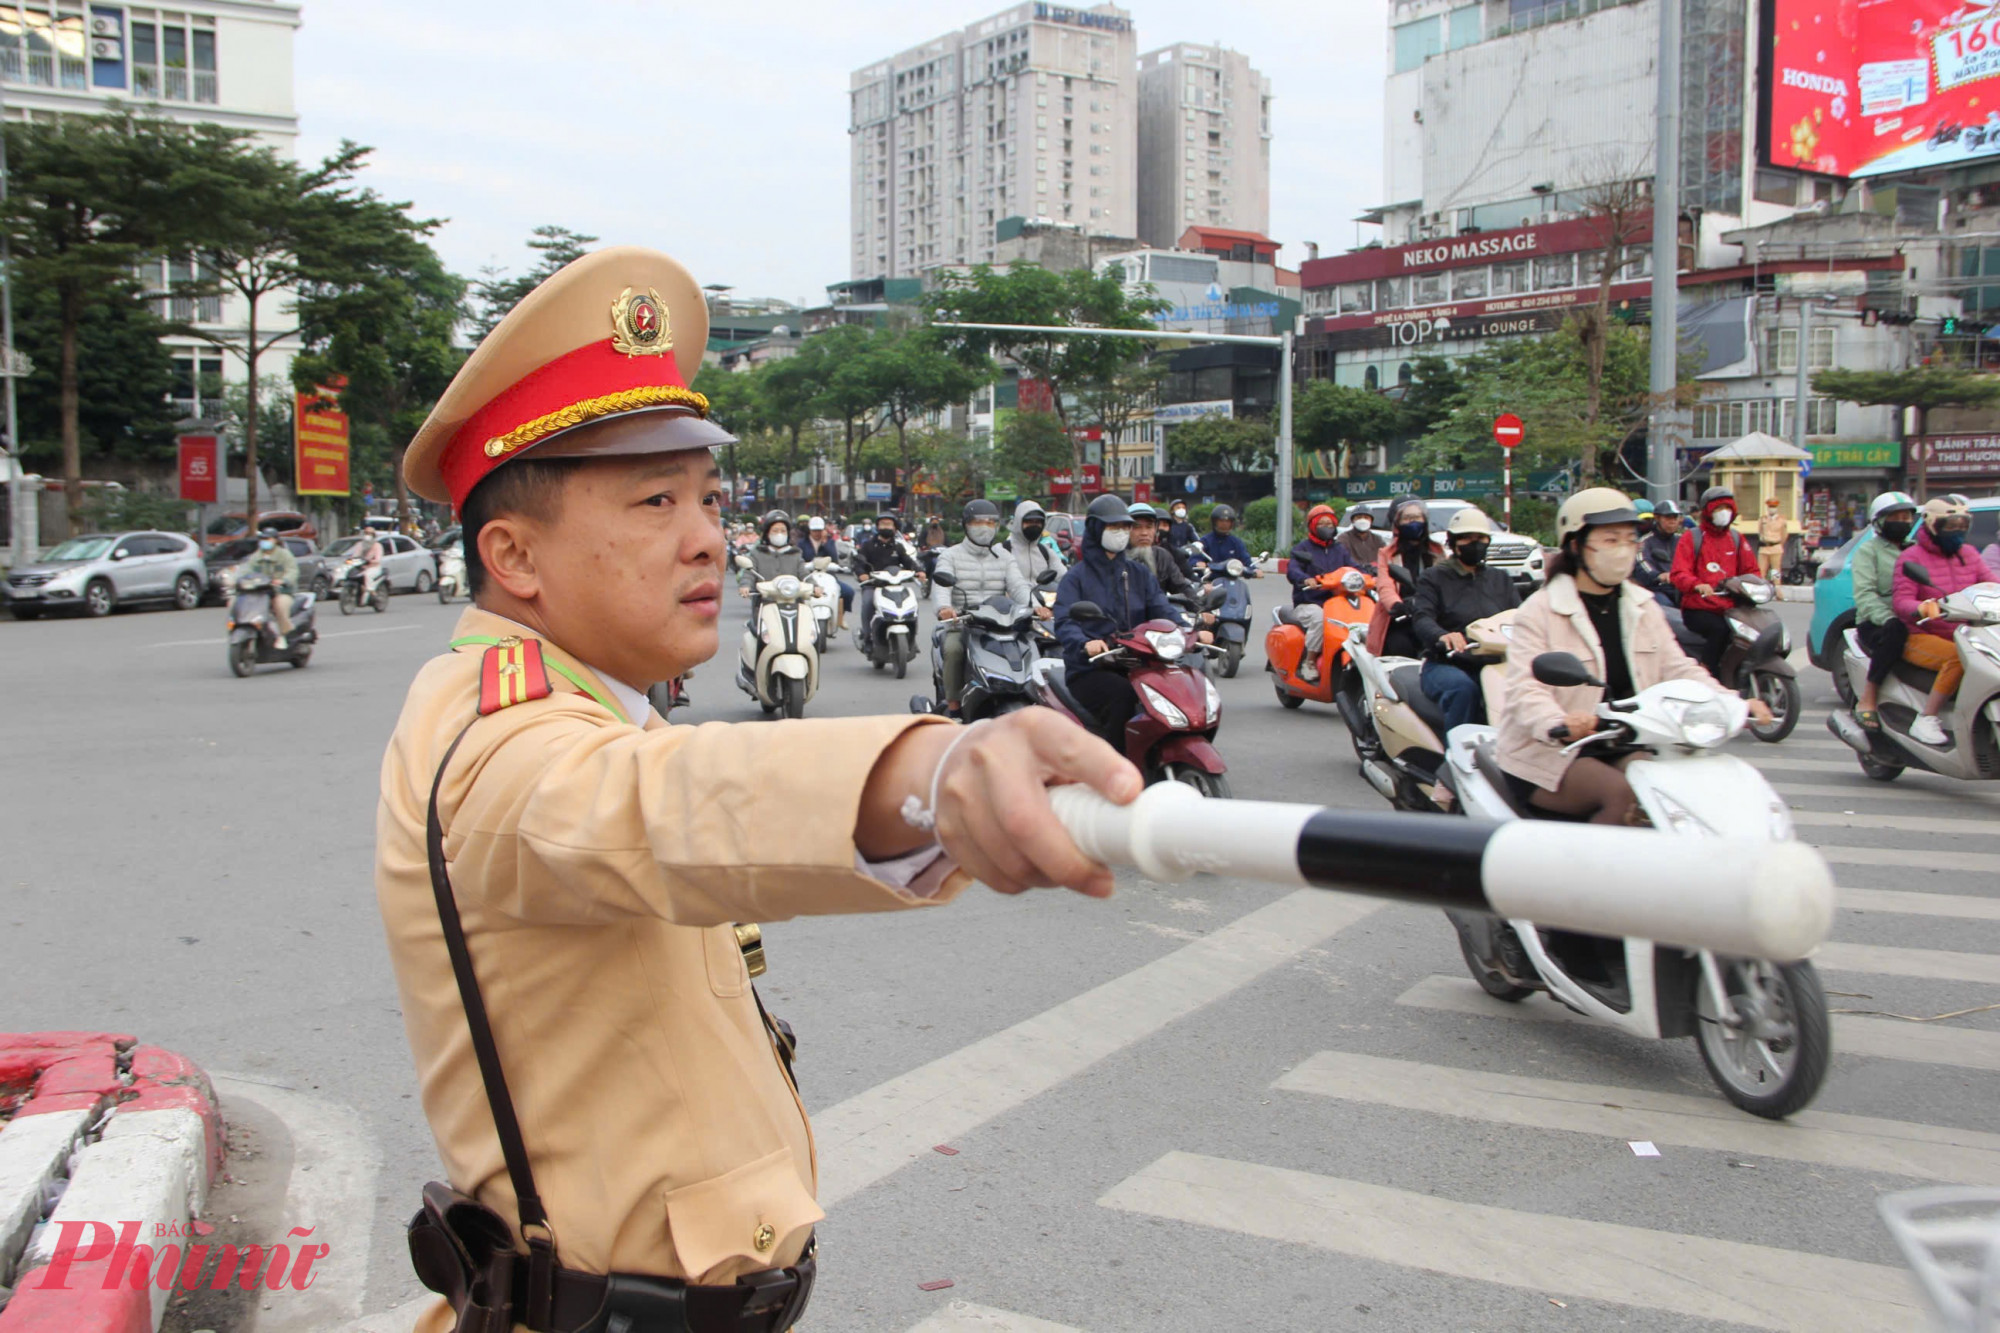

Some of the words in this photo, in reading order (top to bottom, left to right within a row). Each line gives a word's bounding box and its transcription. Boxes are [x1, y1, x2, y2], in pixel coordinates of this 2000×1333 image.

[1952, 60, 1987, 80] WAVE
[1782, 67, 1848, 97] HONDA
[1403, 246, 1448, 267] NEKO
[1451, 233, 1537, 260] MASSAGE
[1394, 313, 1402, 322] LA
[1387, 318, 1433, 346] TOP
[1481, 319, 1536, 336] LOUNGE
[1934, 437, 1970, 450] BÁNH
[1973, 435, 2000, 449] TRÁ
[1937, 452, 1962, 462] THU
[1965, 450, 2000, 461] HƯƠN
[1347, 482, 1368, 494] BIDV
[1390, 481, 1412, 494] BIDV
[1434, 480, 1456, 492] BIDV
